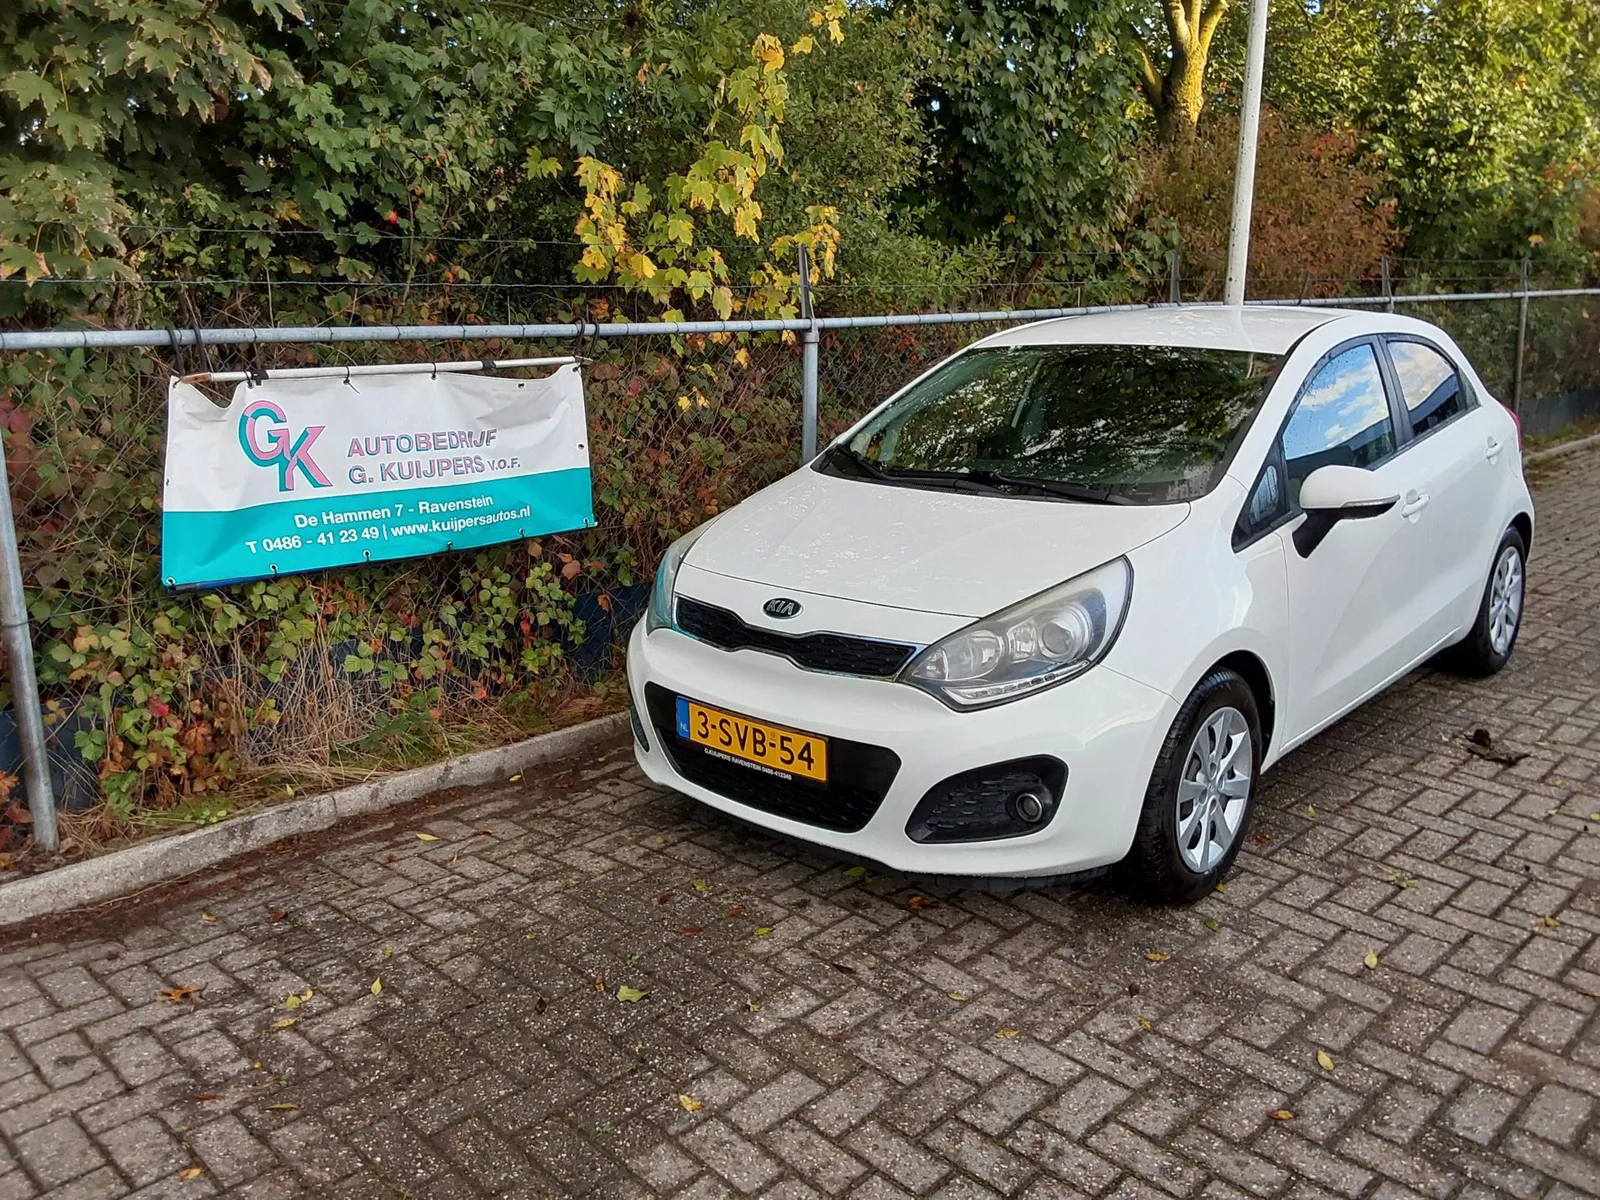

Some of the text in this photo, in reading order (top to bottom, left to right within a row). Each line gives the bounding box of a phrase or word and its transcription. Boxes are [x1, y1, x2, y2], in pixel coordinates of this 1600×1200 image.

[239, 400, 333, 492] GK
[347, 429, 497, 457] AUTOBEDRIJF
[349, 455, 521, 485] G. KUIJPERS V.O.F.
[294, 514, 318, 528] De
[322, 508, 391, 525] Hammen
[394, 504, 404, 517] 7
[418, 495, 494, 514] Ravenstein
[245, 541, 257, 554] T
[262, 536, 302, 552] 0486
[317, 532, 335, 545] 41
[339, 529, 358, 543] 23
[361, 527, 380, 540] 49
[390, 505, 531, 537] www.kuijpersautos.nl
[766, 599, 795, 615] KIA
[680, 722, 689, 732] NL
[697, 711, 815, 771] 3-SVB-54
[731, 757, 761, 771] RAVENSTEIN
